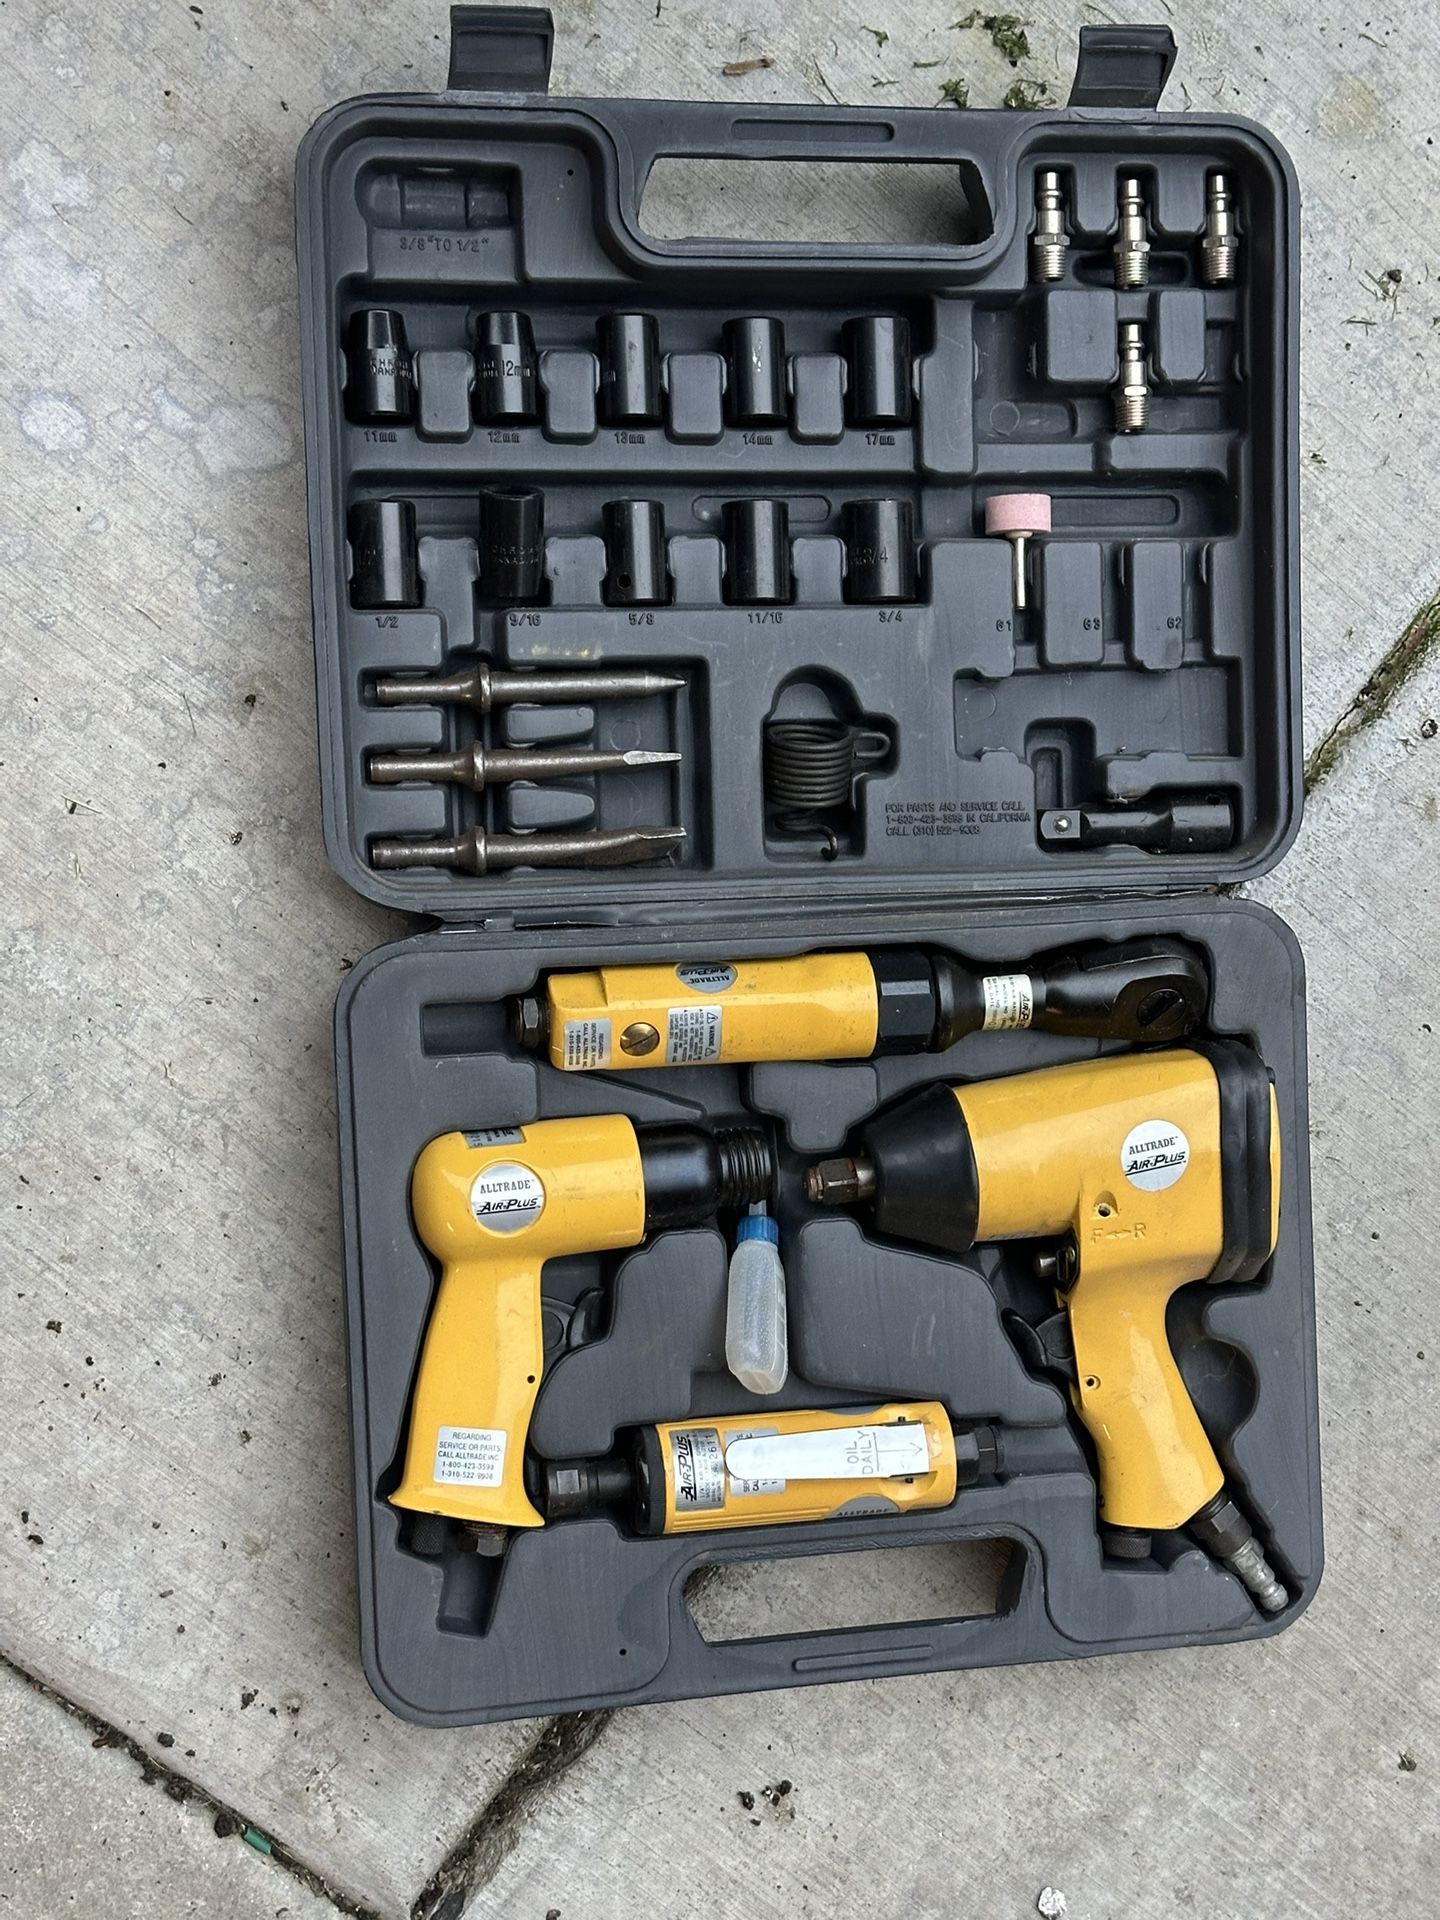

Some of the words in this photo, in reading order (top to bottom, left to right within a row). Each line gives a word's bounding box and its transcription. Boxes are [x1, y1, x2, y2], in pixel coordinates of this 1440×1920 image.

[364, 431, 397, 443] 11mm
[488, 432, 520, 443] 12mm
[614, 432, 646, 444] 13mm
[742, 433, 773, 445] 14mm
[865, 433, 896, 445] 17mm
[375, 616, 399, 628] 1/2
[509, 614, 542, 627] 9/16
[628, 612, 655, 625] 5/8
[747, 612, 783, 625] 11/16
[878, 610, 903, 623] 3/4
[1167, 616, 1182, 629] G2
[885, 803, 904, 813] FOR
[906, 802, 935, 812] PARTS
[938, 802, 956, 812] AND
[960, 801, 998, 812] SERVICE
[1001, 801, 1025, 811] CALL
[979, 812, 1031, 823] CALIFORNIA
[885, 825, 911, 836] CALL
[690, 975, 730, 985] ALLTRADE
[1128, 1136, 1176, 1156] ALLTRADE
[480, 1180, 531, 1194] ALLTRADE
[452, 1432, 492, 1442] REGARDING
[439, 1441, 467, 1451] SERVICE
[468, 1443, 479, 1451] OR
[845, 1440, 859, 1464] OIL
[438, 1451, 454, 1459] CALL
[455, 1452, 487, 1461] ALLTRADE
[857, 1430, 874, 1475] DAILY
